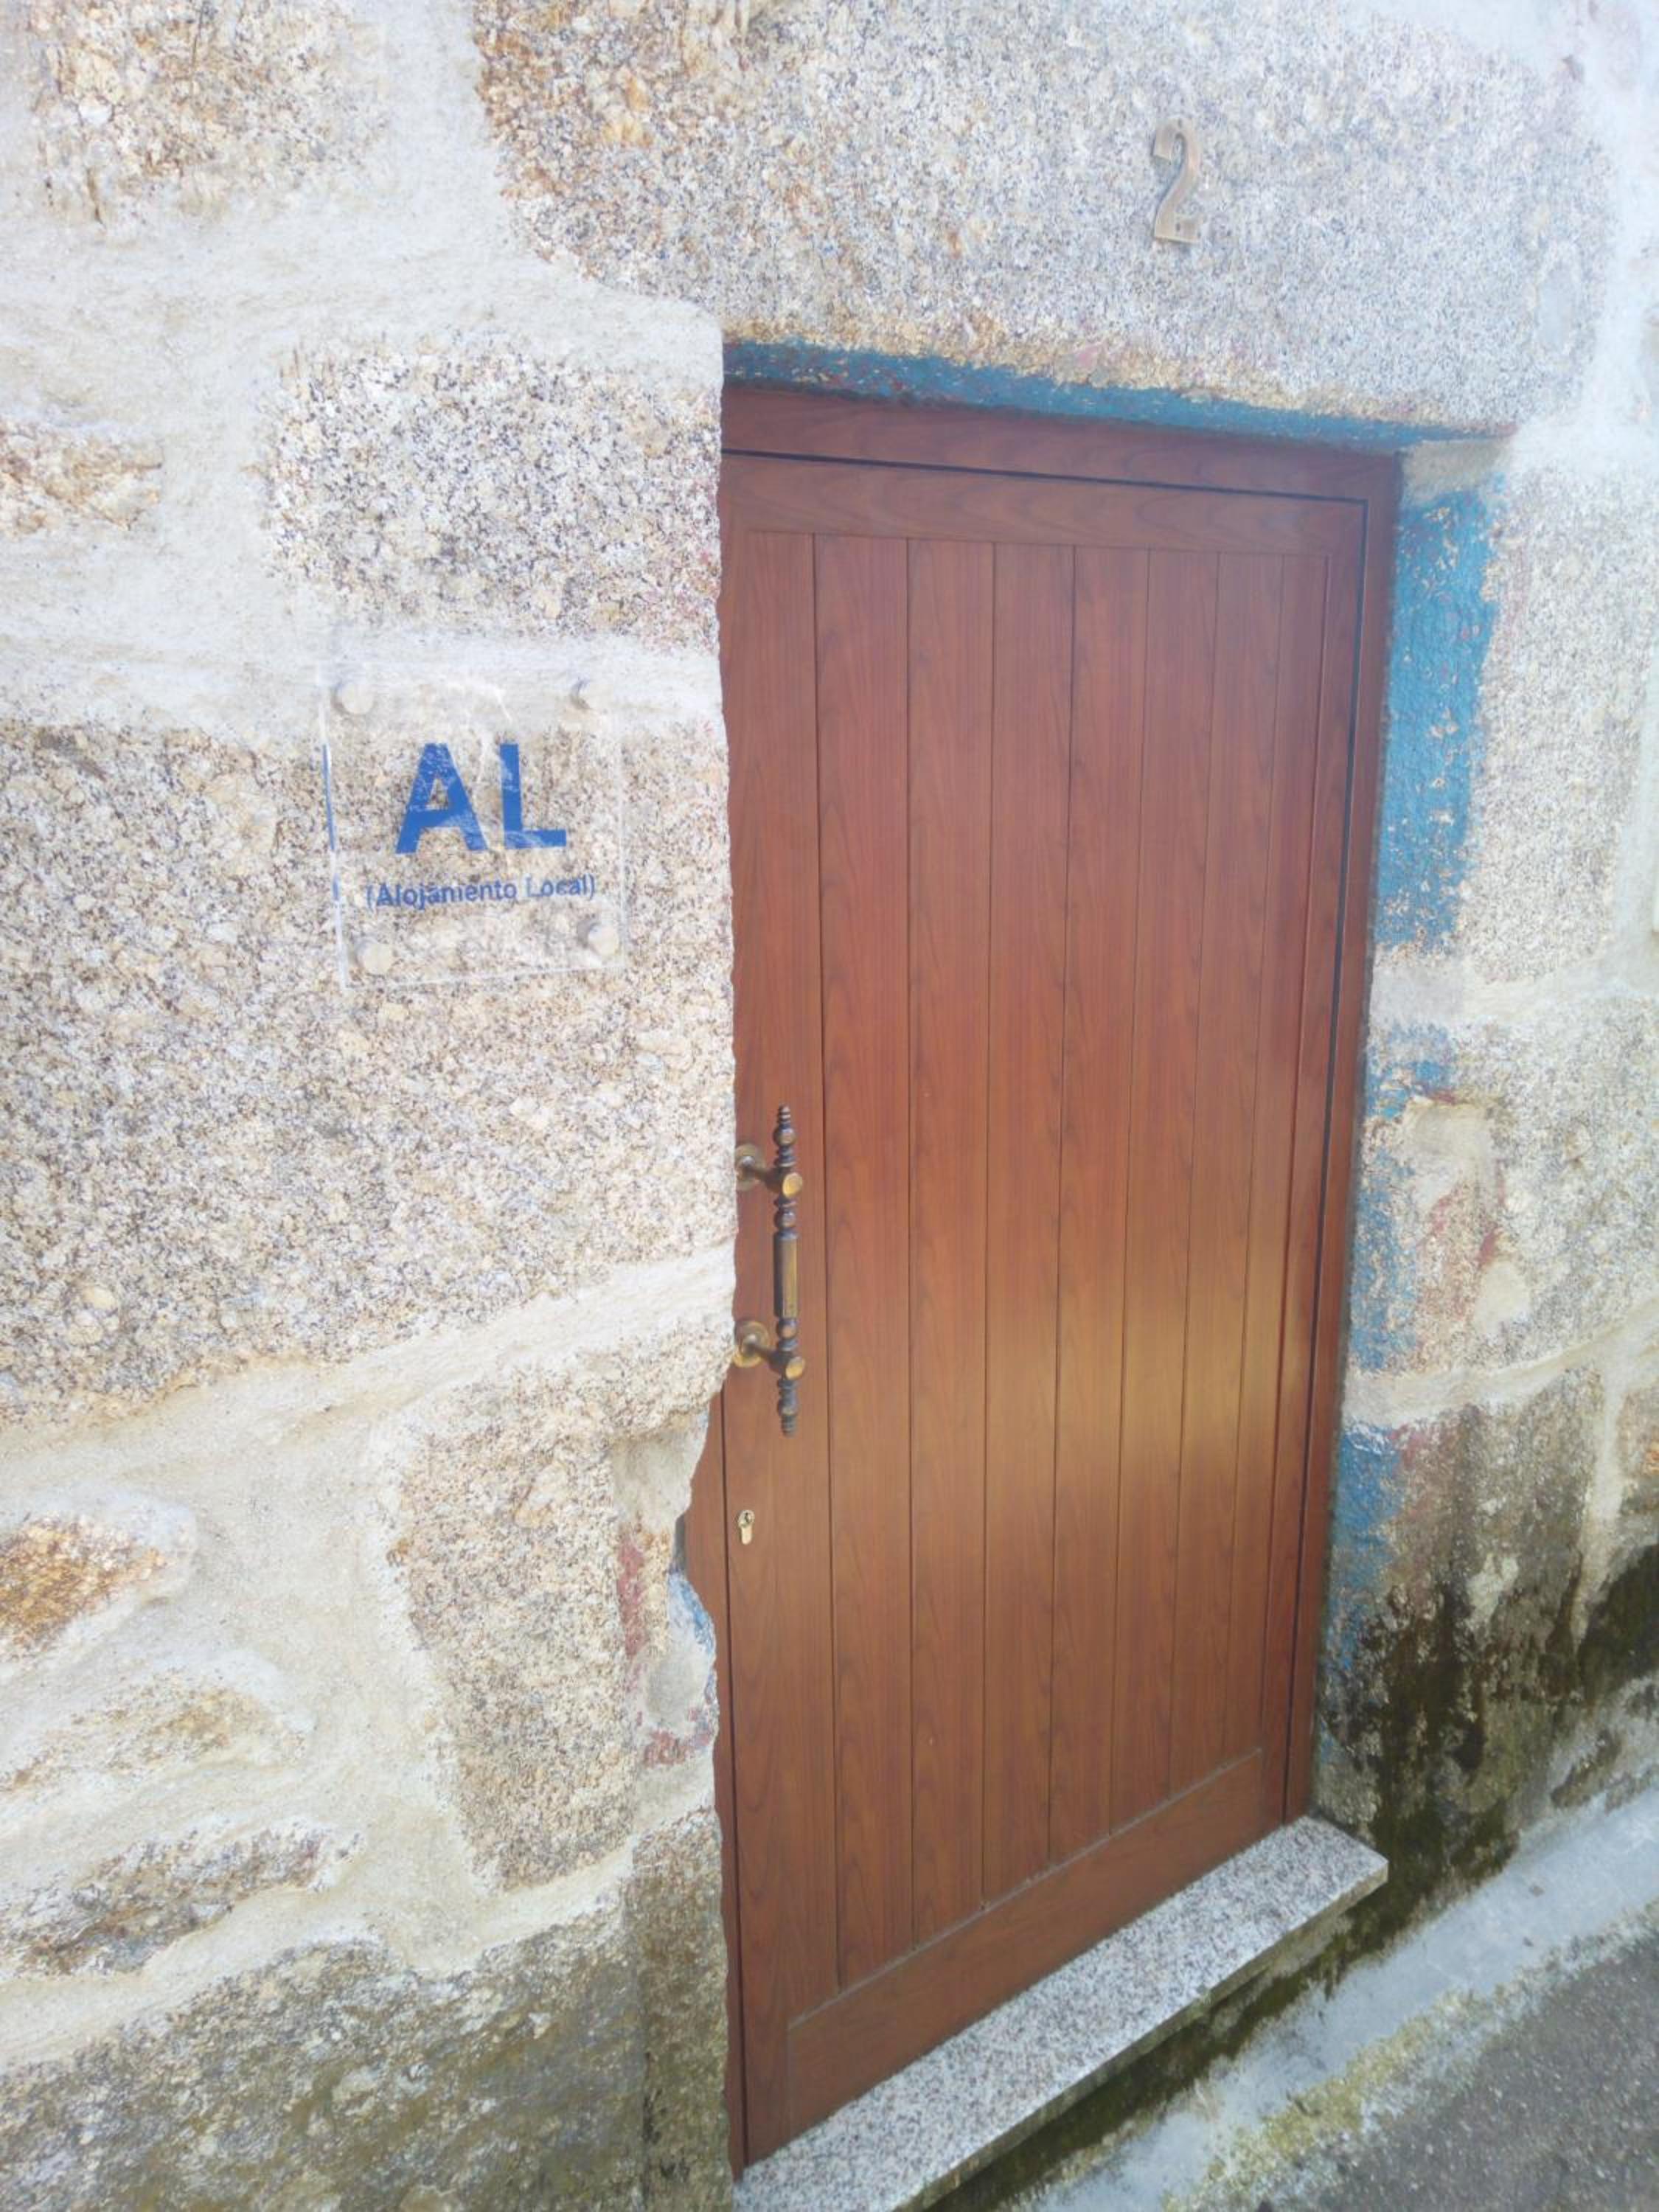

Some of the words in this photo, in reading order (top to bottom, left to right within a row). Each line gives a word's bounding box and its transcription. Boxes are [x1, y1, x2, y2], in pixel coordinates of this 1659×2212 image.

[1151, 116, 1203, 243] 2
[396, 743, 567, 855] AL
[526, 874, 596, 900] Local)
